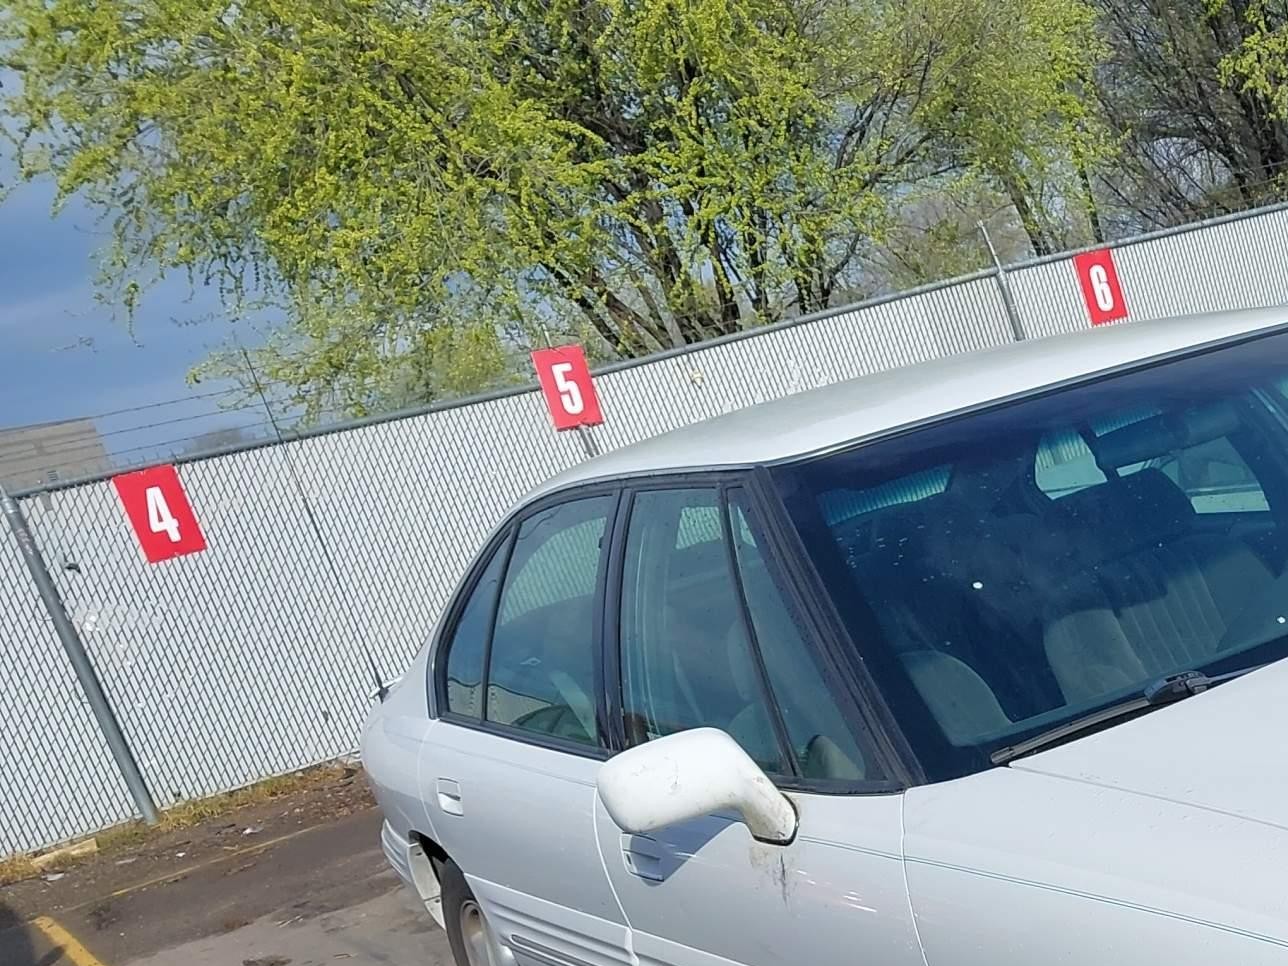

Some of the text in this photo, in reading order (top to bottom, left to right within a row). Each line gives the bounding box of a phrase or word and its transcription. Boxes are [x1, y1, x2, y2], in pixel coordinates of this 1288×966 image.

[1089, 264, 1114, 312] 6
[551, 362, 584, 414] 5
[146, 486, 181, 542] 4
